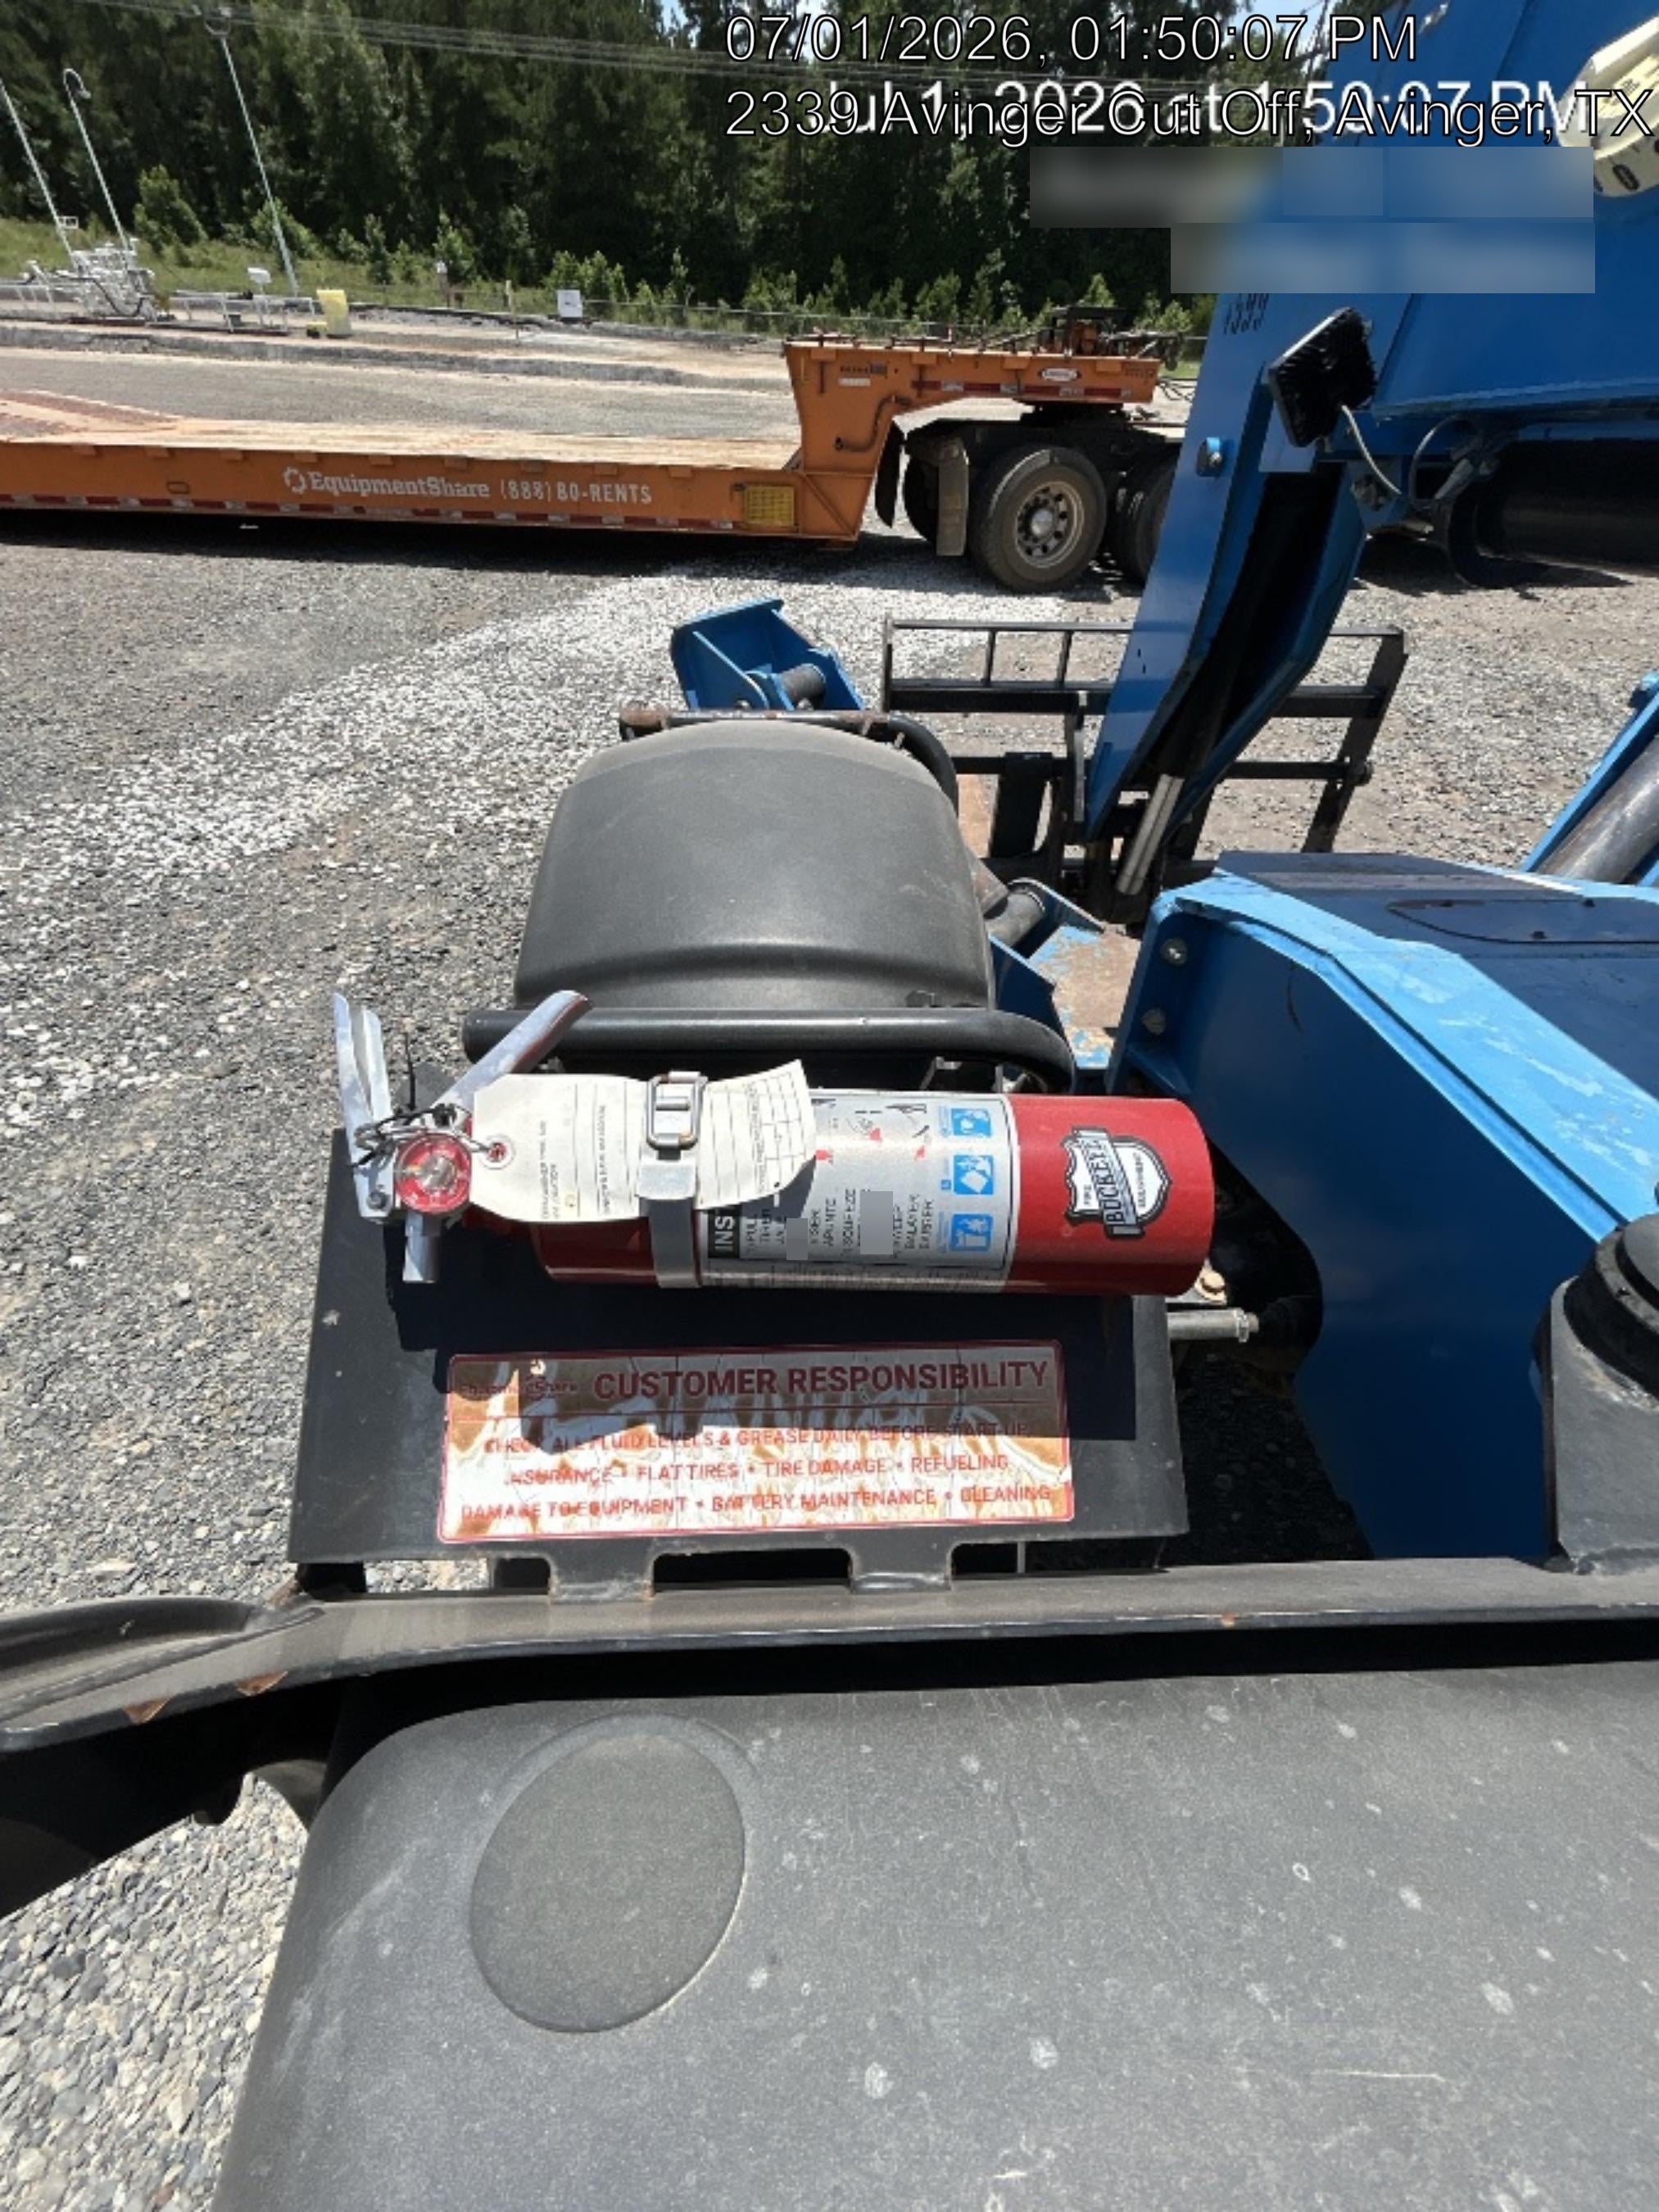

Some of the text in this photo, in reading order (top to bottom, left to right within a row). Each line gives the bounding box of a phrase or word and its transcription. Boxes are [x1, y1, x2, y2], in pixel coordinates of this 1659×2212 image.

[308, 472, 491, 497] EquipmentShare
[501, 478, 551, 502] (888)
[714, 1214, 736, 1253] INS
[594, 1367, 777, 1399] CUSTOMER
[787, 1361, 1048, 1394] RESPONSIBILITY
[737, 1427, 809, 1446] GREASE
[637, 1464, 682, 1481] FLAT
[686, 1462, 740, 1480] TIRES
[764, 1461, 804, 1478] TIRE
[808, 1457, 886, 1476] DAMAGE
[911, 1454, 1009, 1473] REFUELING
[576, 1496, 687, 1517] EQUIPMENT
[800, 1488, 936, 1509] MAINTENANCE
[959, 1484, 1051, 1503] CLEANING
